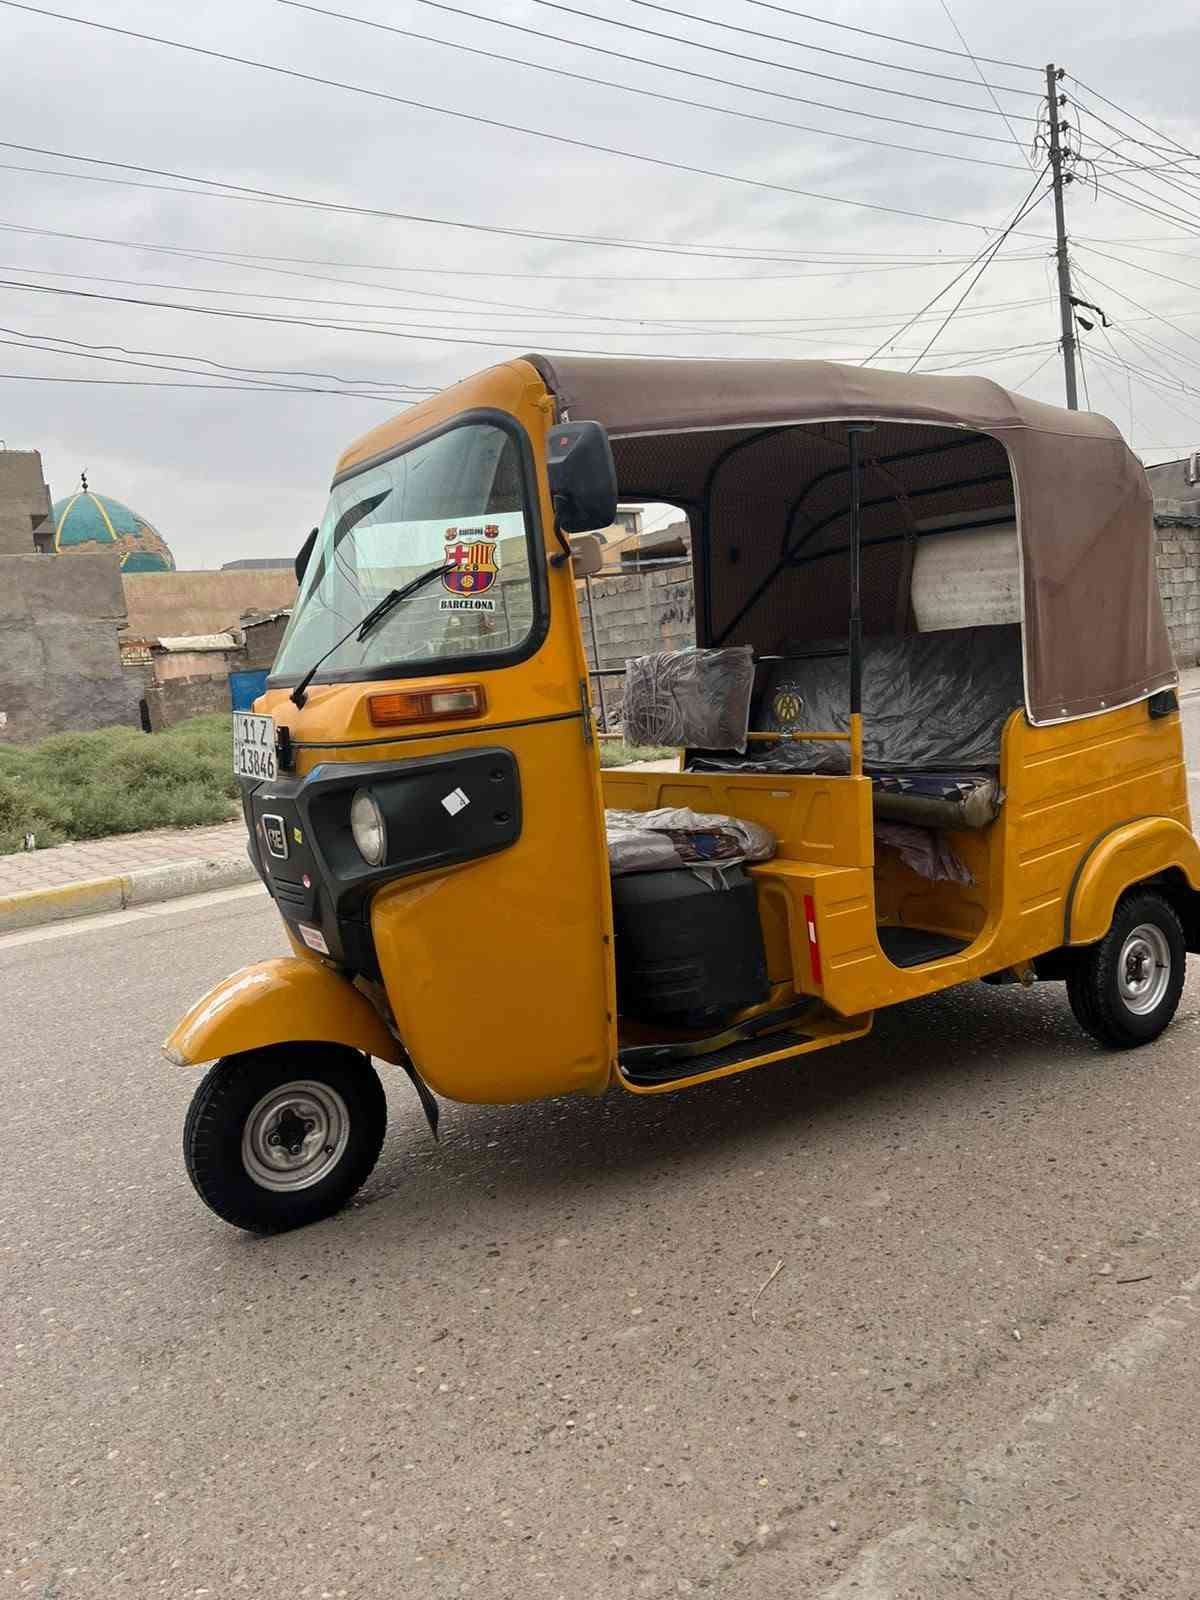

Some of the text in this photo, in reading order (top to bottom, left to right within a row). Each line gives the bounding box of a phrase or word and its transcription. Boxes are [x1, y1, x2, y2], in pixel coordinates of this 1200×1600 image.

[440, 600, 494, 610] BARCELONA
[243, 719, 256, 744] 11
[240, 748, 274, 779] 13846
